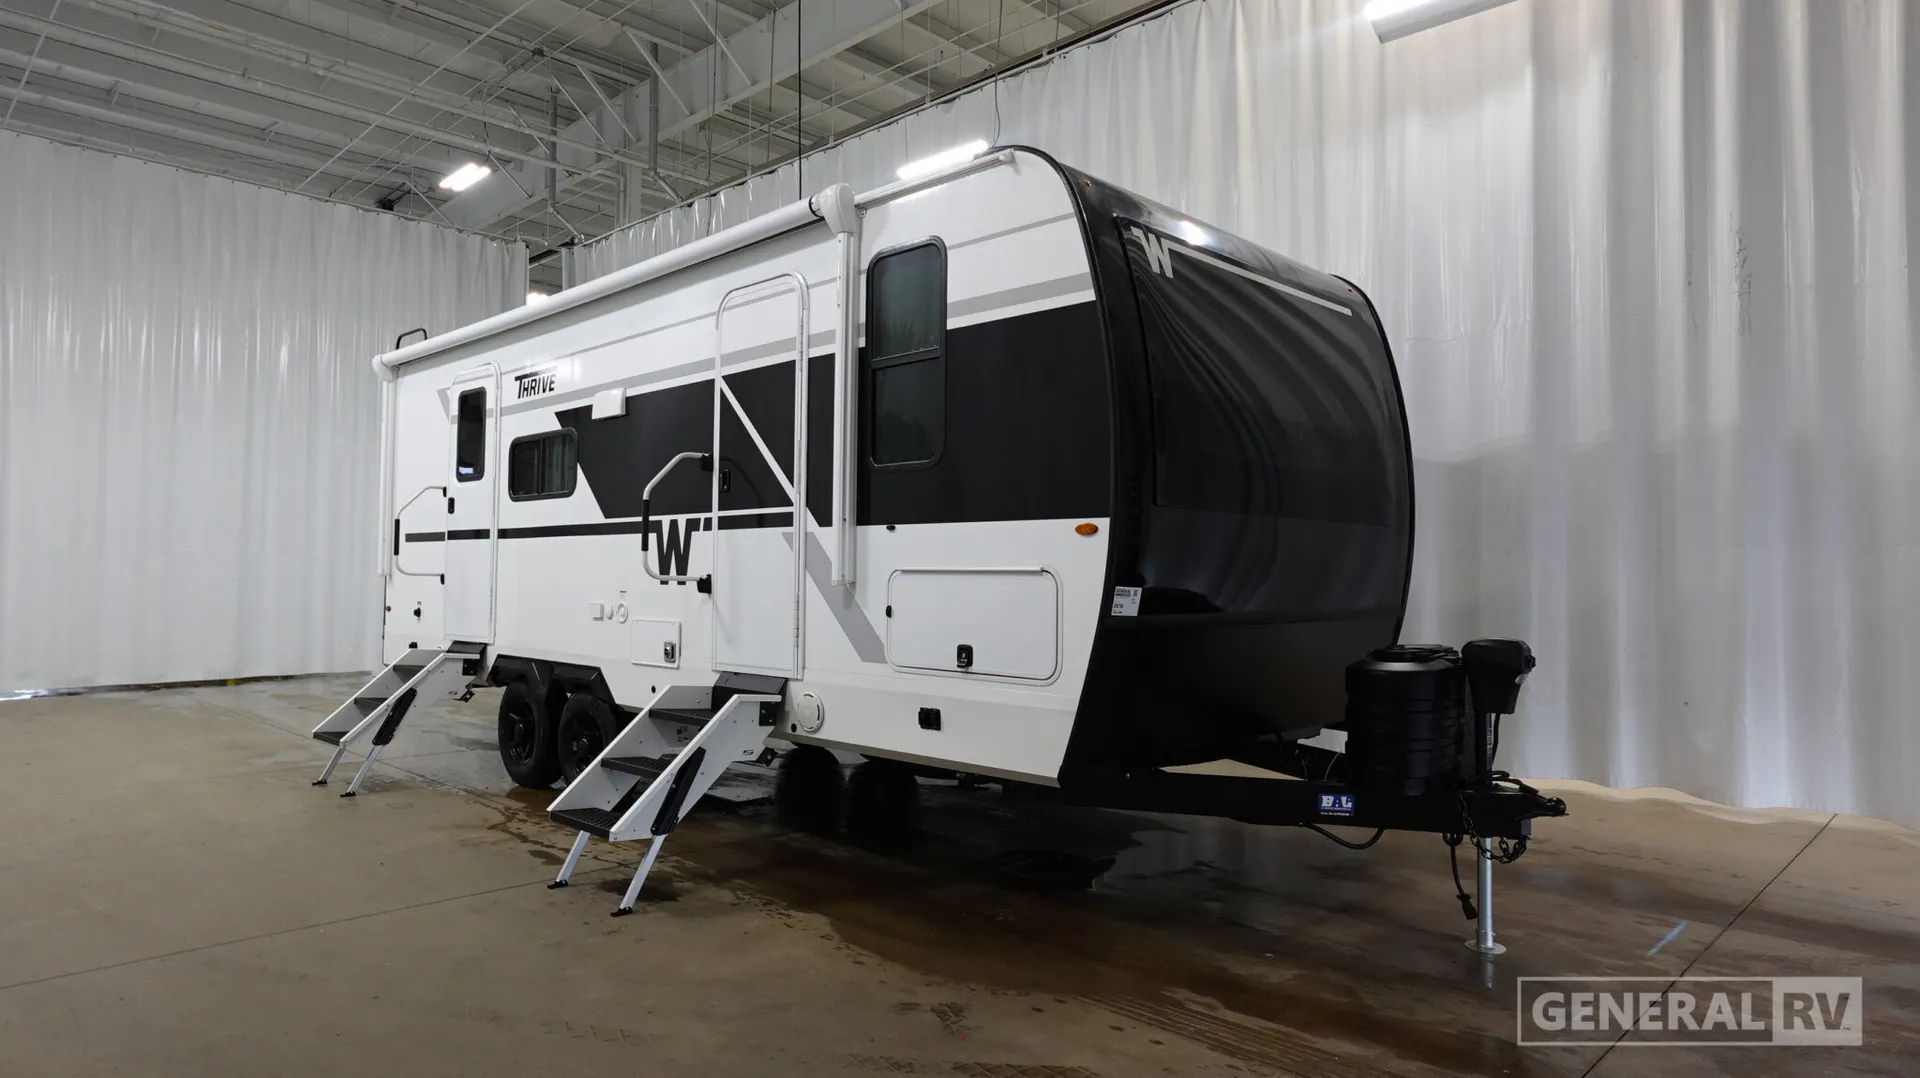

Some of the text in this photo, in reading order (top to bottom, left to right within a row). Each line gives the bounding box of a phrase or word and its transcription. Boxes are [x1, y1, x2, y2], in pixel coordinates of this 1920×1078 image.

[1129, 225, 1174, 279] W
[514, 367, 557, 399] THRIVE
[655, 517, 702, 586] W
